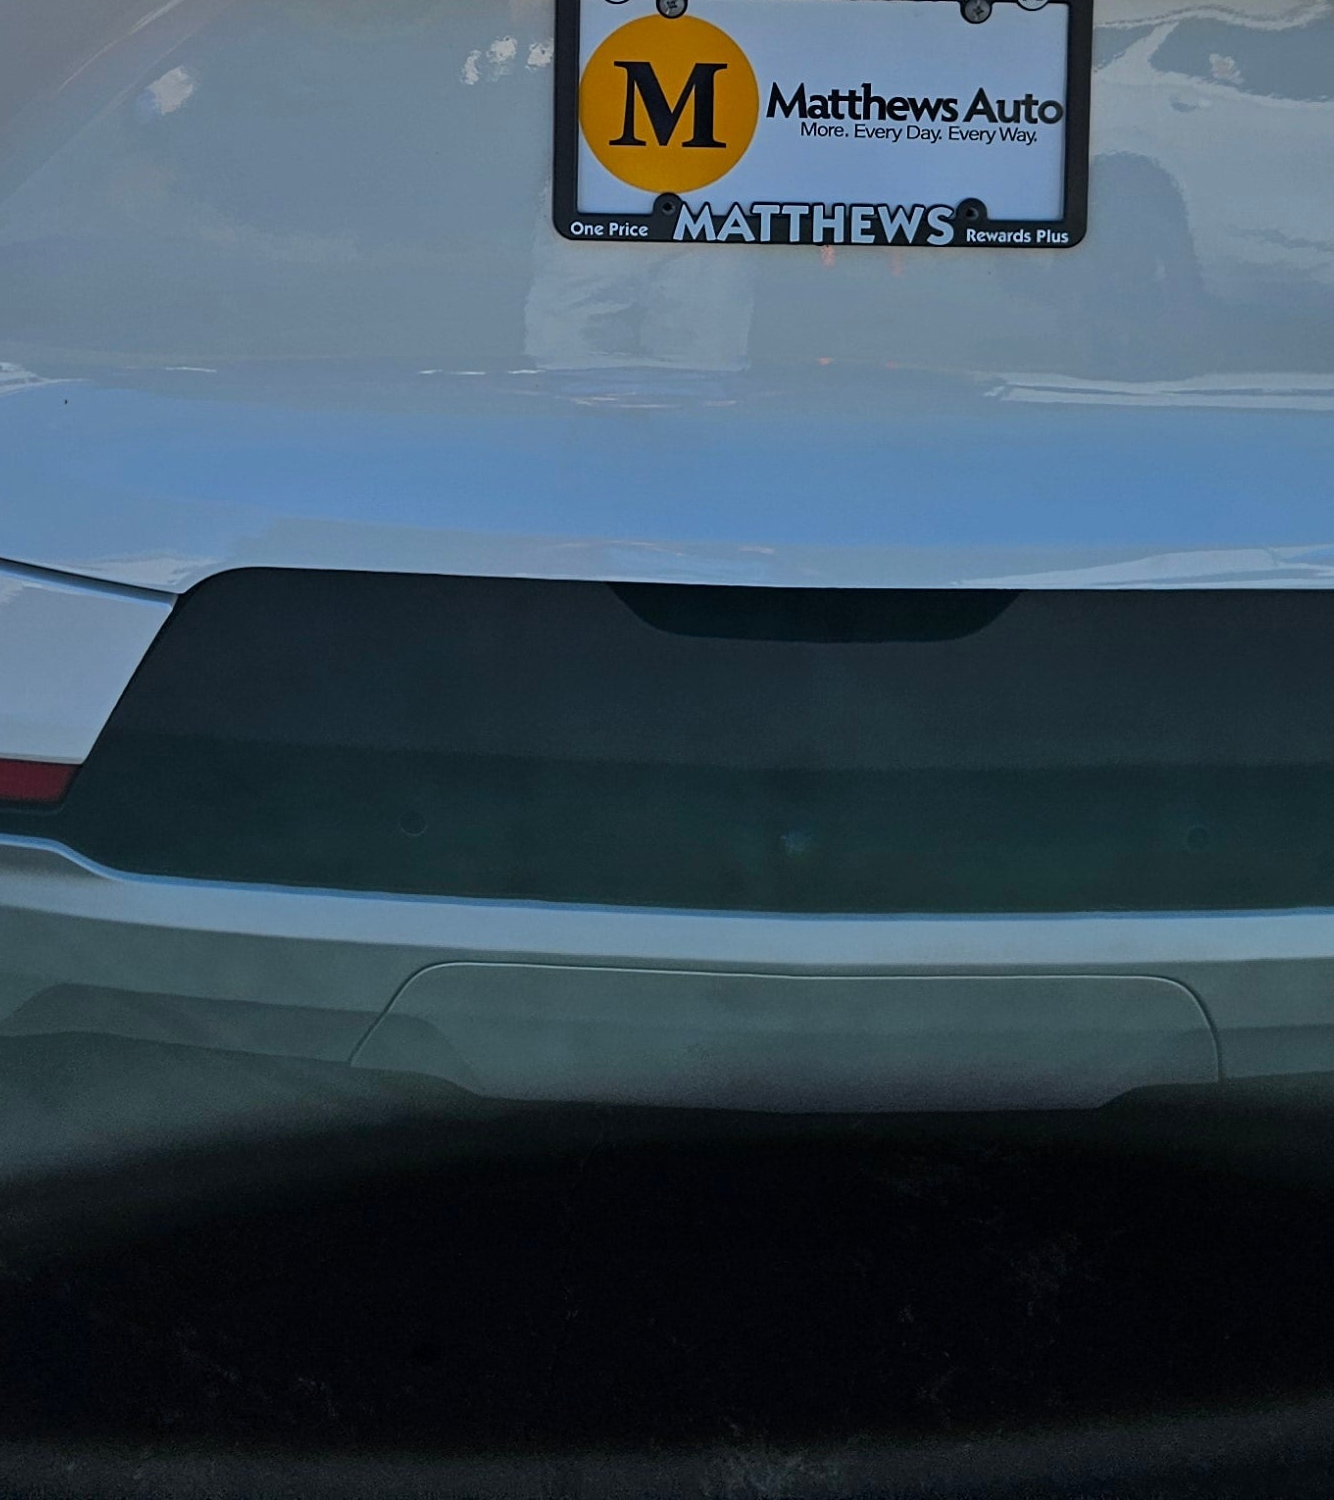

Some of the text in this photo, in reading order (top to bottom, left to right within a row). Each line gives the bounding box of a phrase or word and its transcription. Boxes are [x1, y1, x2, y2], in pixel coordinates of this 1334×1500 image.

[608, 60, 728, 149] M
[766, 81, 1064, 125] Matthews Auto
[800, 121, 1038, 146] More. Every Day. Every Way.
[570, 221, 649, 237] One Price
[672, 203, 955, 246] MATTHEWS
[966, 228, 1070, 244] Rewards Plus
